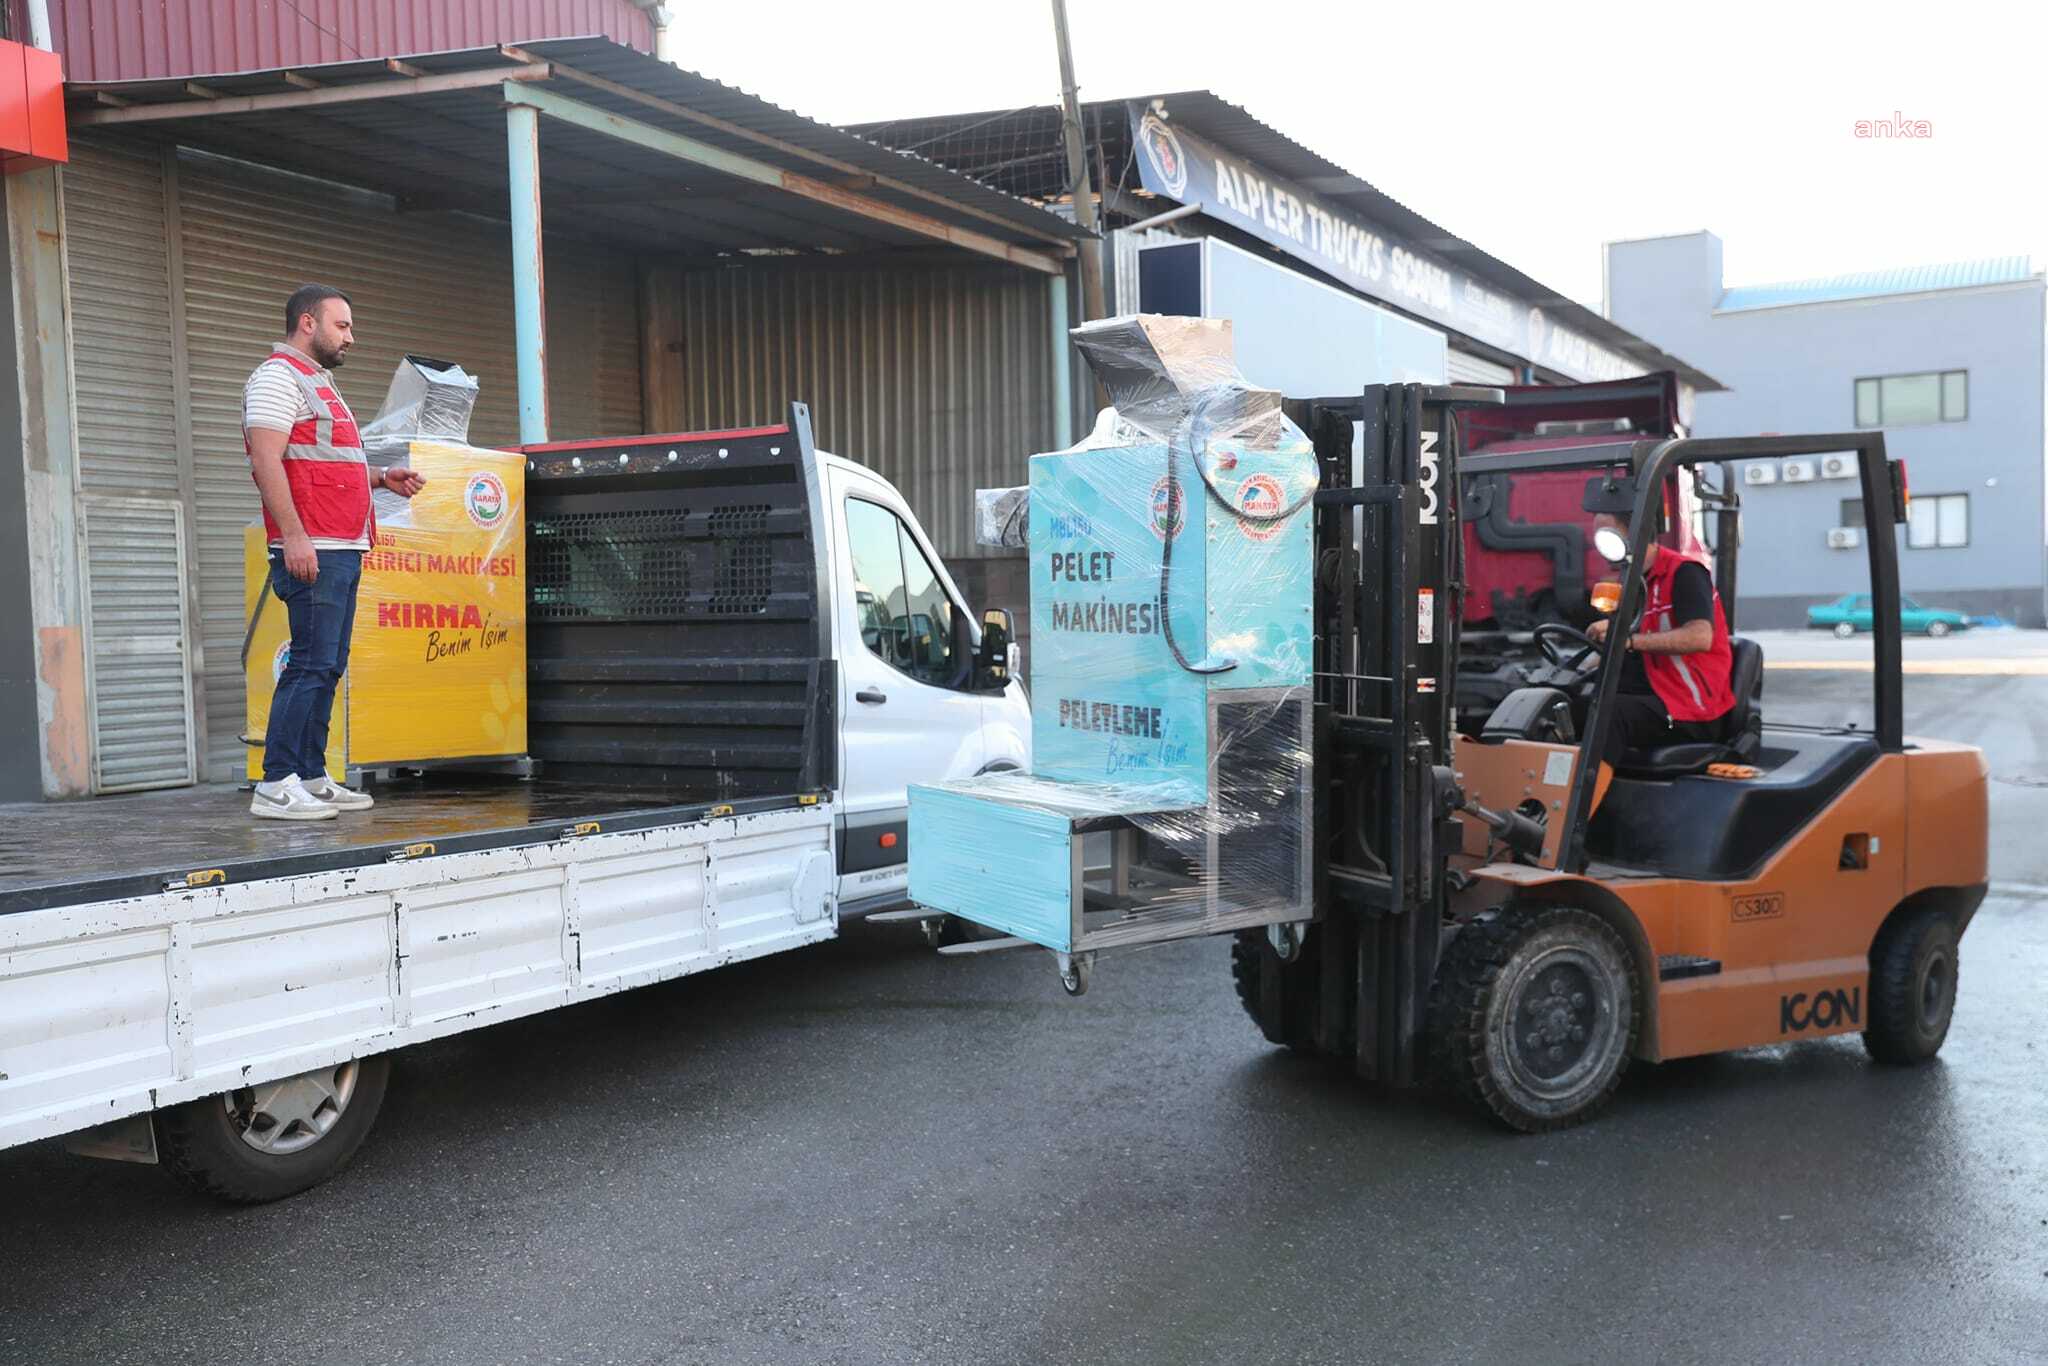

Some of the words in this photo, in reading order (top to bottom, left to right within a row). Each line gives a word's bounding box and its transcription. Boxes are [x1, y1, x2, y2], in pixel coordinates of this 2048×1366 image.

[1215, 158, 1305, 246] ALPLER
[1306, 204, 1384, 281] TRUCKS
[1391, 246, 1453, 313] SCANIA
[1419, 431, 1439, 524] ICON
[363, 550, 422, 573] KIRICI
[427, 552, 516, 577] MAKİNESİ
[1051, 551, 1116, 582] PELET
[378, 602, 483, 629] KIRMA
[1052, 594, 1160, 635] MAKİNESİ
[426, 630, 471, 663] Benim
[481, 612, 508, 649] İşim
[1059, 699, 1162, 739] PELETLEME
[1780, 986, 1860, 1035] ICON
